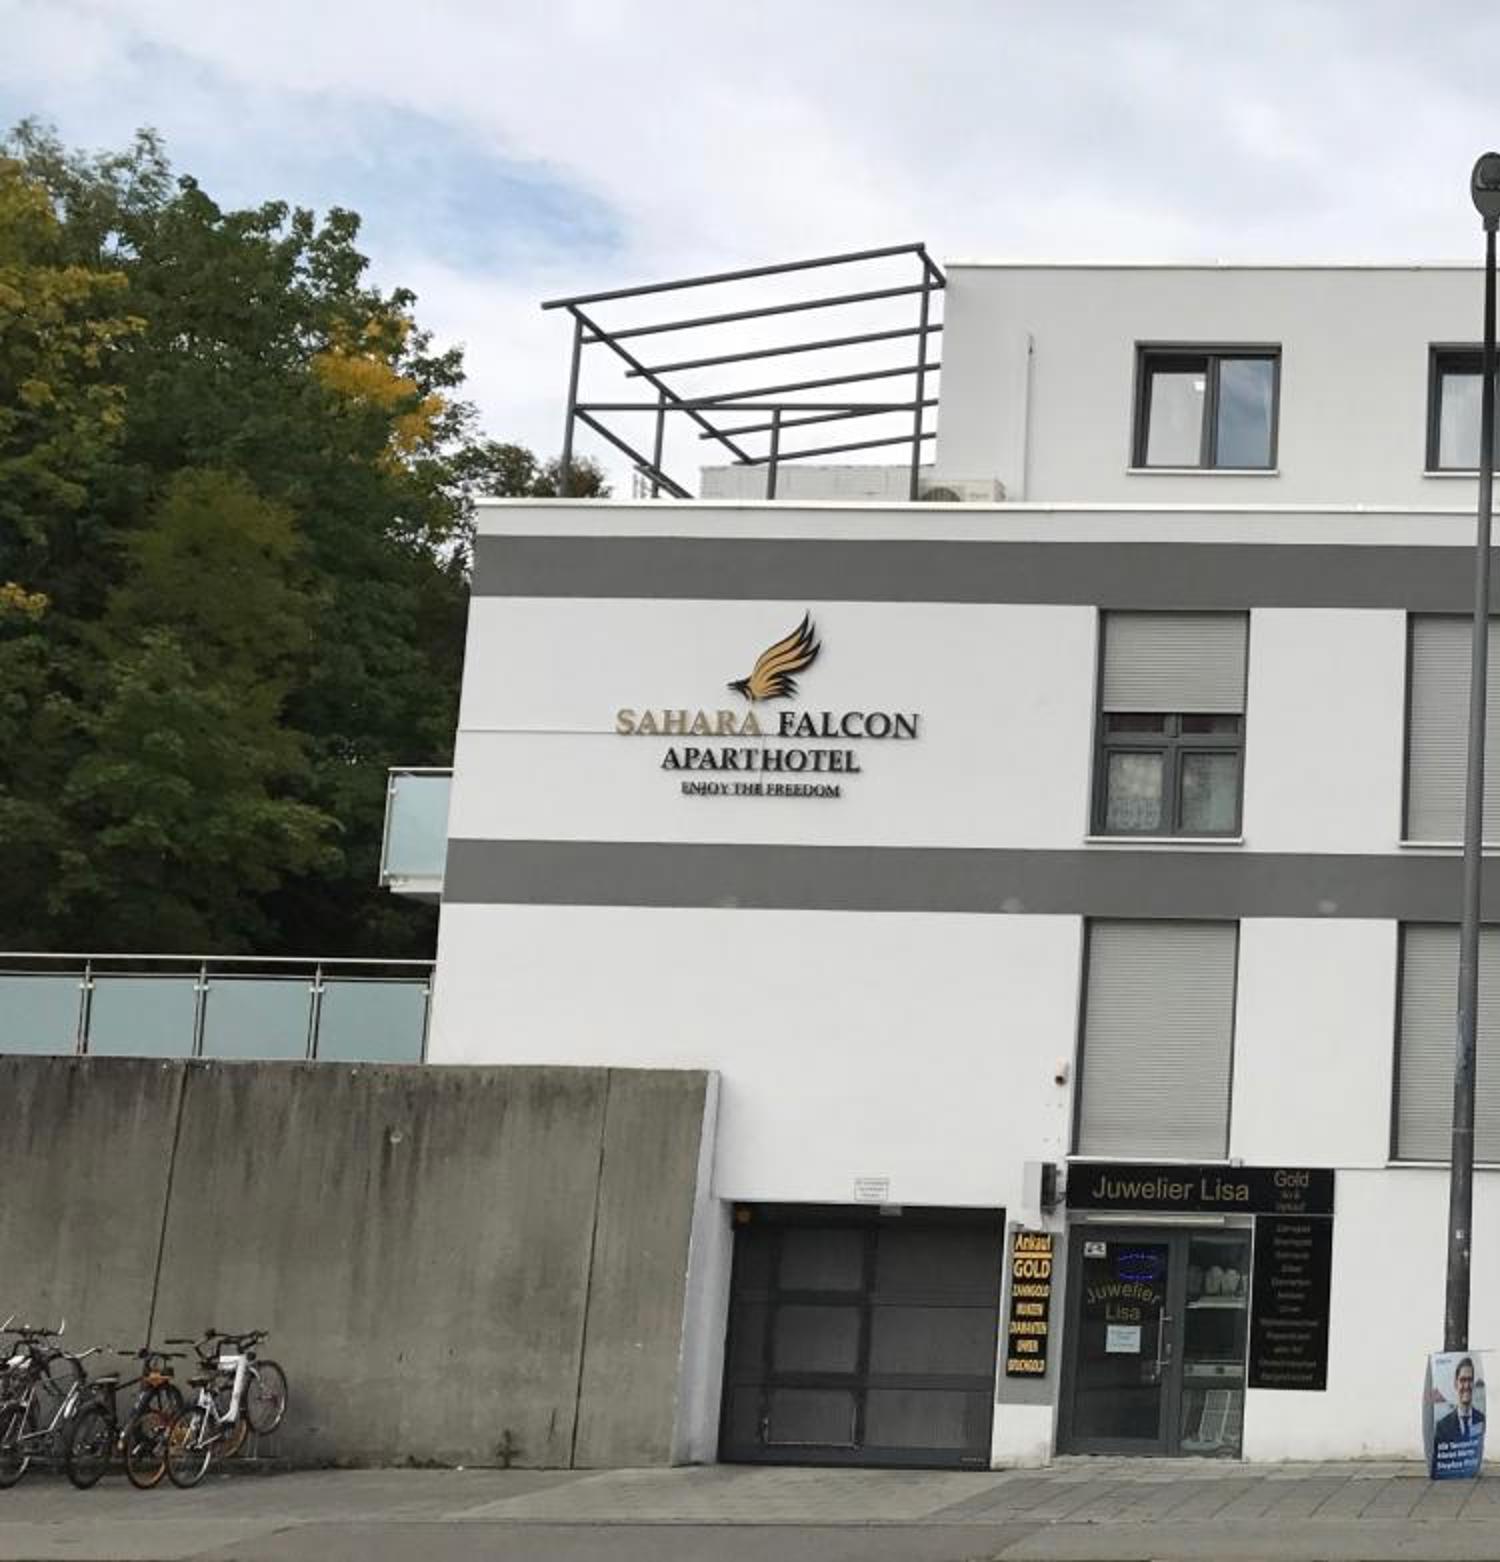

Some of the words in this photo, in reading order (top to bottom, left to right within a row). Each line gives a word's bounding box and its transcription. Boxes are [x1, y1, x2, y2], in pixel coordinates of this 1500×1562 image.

[615, 709, 762, 736] SAHARA
[778, 711, 919, 739] FALCON
[661, 747, 861, 773] APARTHOTEL
[681, 781, 729, 796] ENJOY
[734, 782, 763, 796] THE
[765, 783, 841, 798] FREEDOM
[1274, 1170, 1310, 1188] Gold
[1092, 1176, 1194, 1200] Juwelier
[1201, 1180, 1250, 1202] Lisa
[1014, 1260, 1050, 1278] GOLD
[1087, 1283, 1160, 1304] Juwelier
[1105, 1303, 1141, 1321] Lisa
